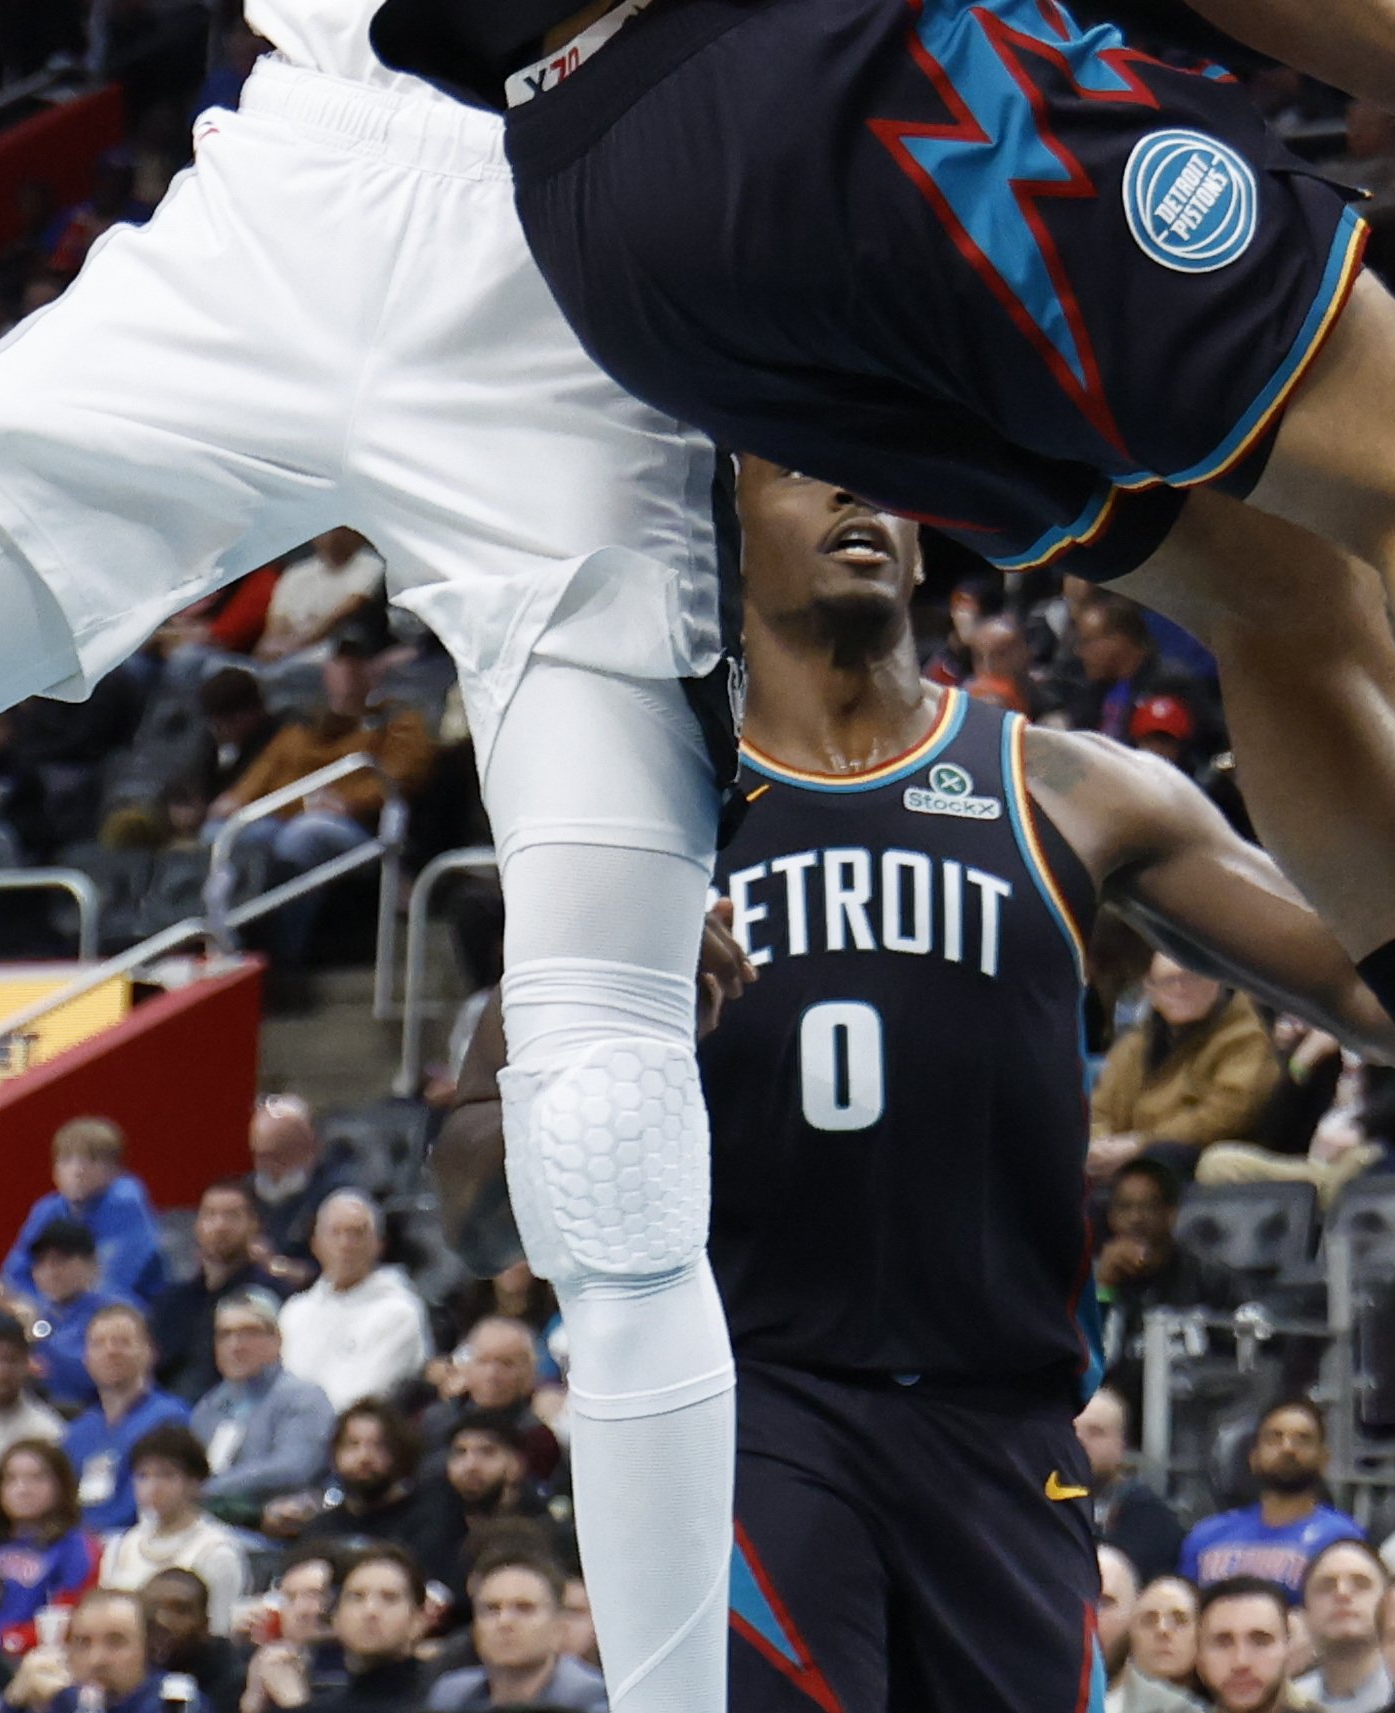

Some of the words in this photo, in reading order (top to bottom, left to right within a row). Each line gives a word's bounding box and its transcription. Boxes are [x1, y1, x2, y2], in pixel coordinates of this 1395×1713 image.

[1154, 151, 1210, 226] DETROIT
[1169, 166, 1230, 242] PISTONS
[907, 792, 996, 816] StockX
[800, 999, 887, 1132] 0
